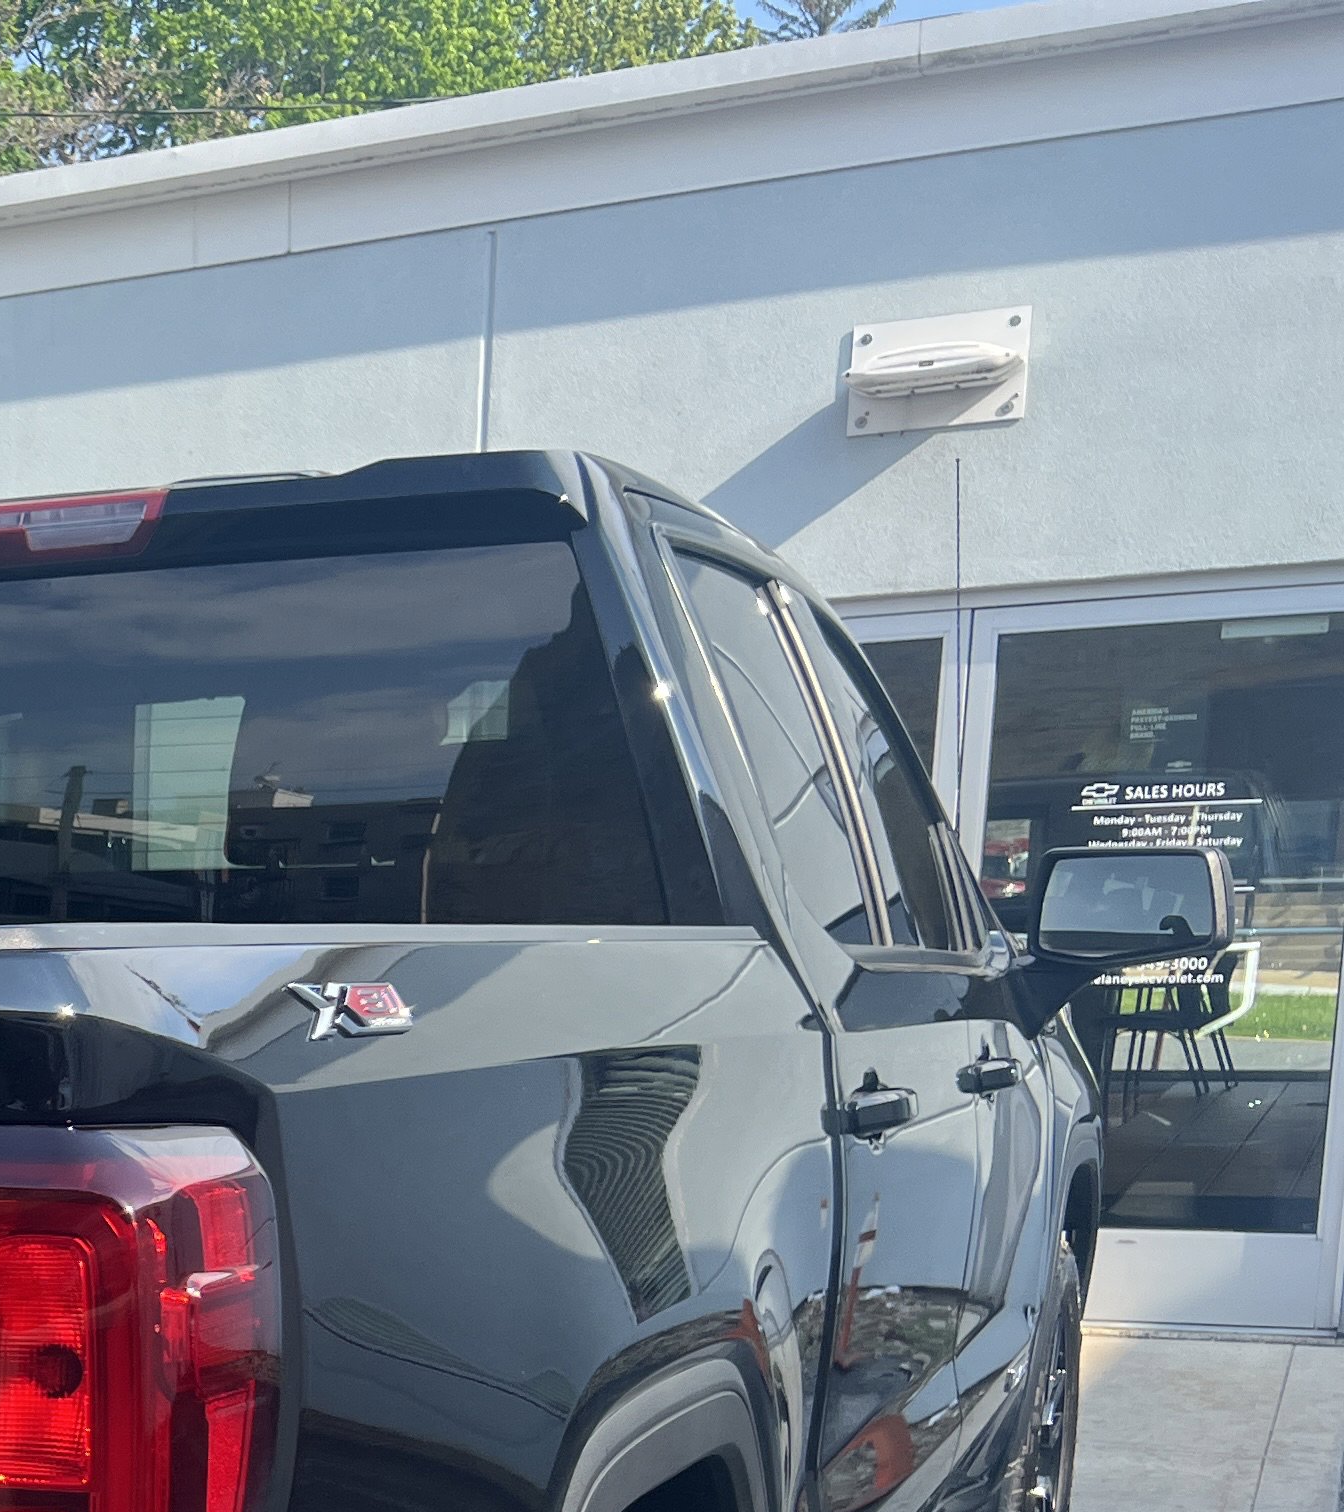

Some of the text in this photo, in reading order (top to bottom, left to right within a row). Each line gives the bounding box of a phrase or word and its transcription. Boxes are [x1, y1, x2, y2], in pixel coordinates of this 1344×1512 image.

[1125, 782, 1226, 800] SALES HOURS
[1093, 815, 1136, 826] Monday
[1144, 813, 1186, 825] Tuesday
[1196, 836, 1243, 848] Saturday
